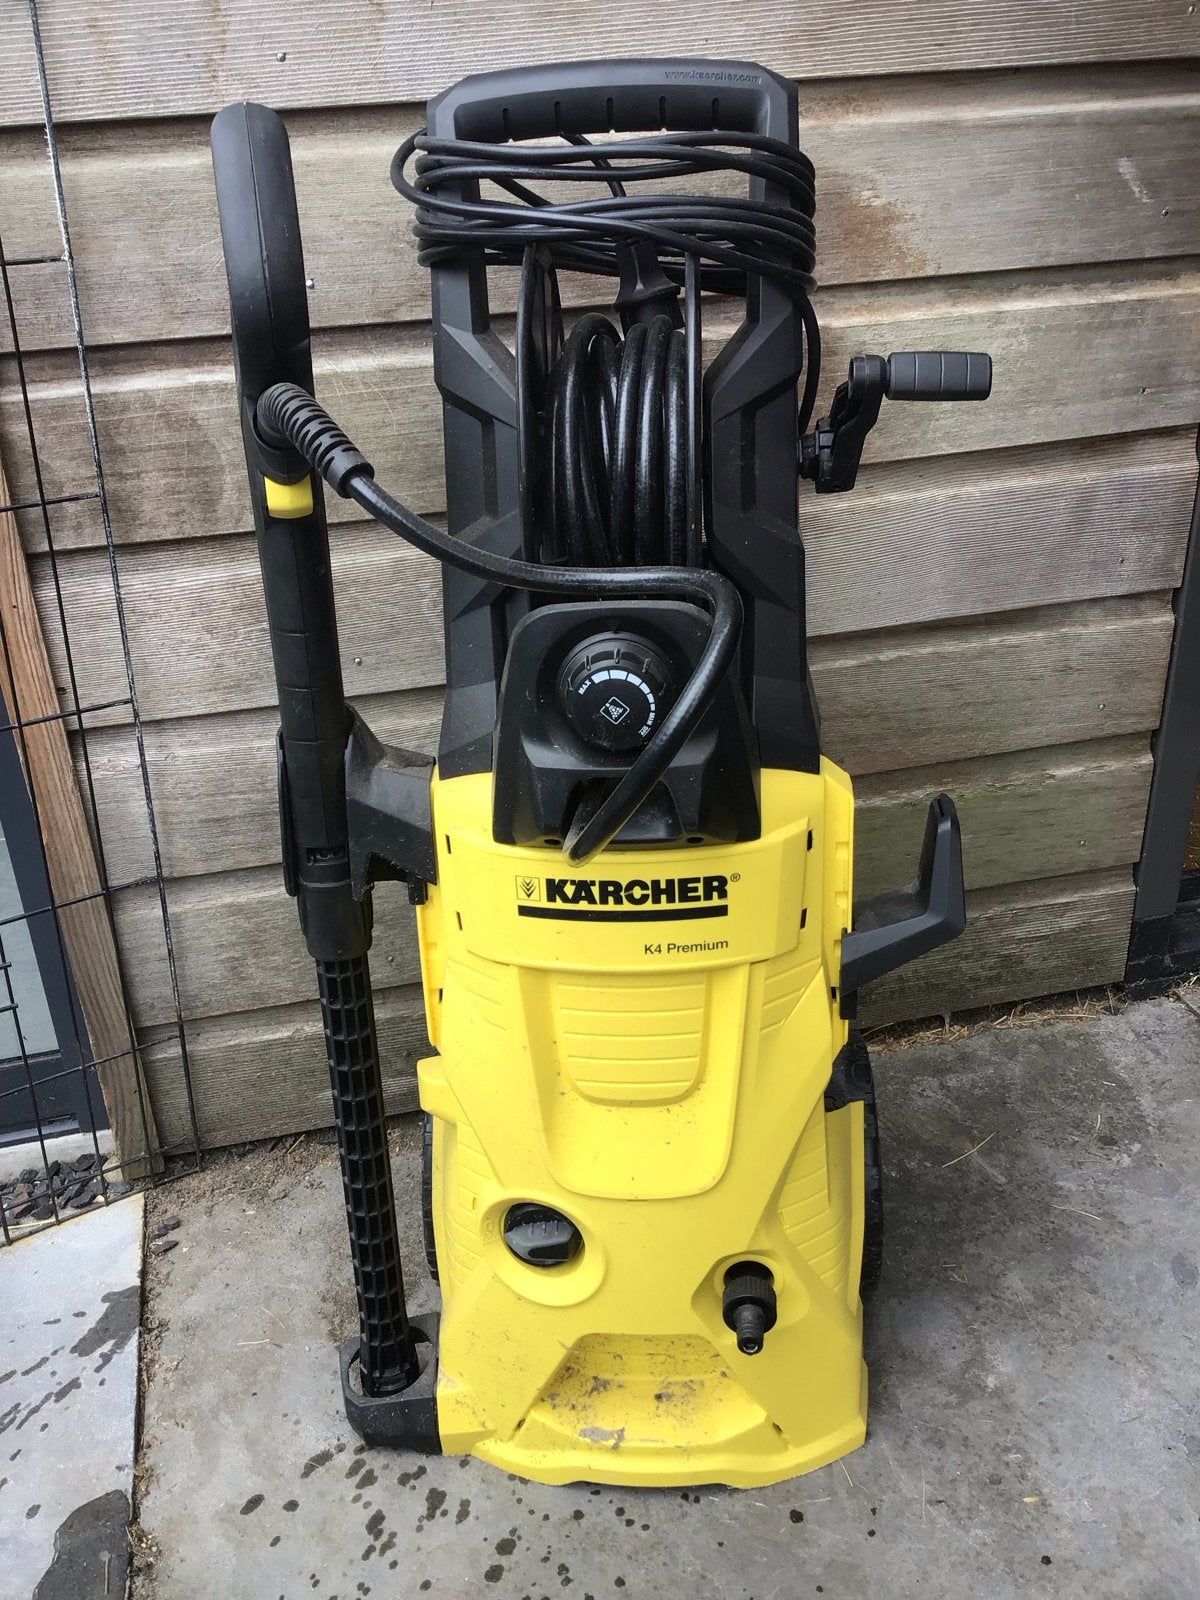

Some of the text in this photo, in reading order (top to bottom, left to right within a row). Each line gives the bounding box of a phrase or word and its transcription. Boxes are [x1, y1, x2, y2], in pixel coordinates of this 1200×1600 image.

[664, 70, 762, 84] www.kaercher.com
[578, 679, 592, 695] MAX
[644, 940, 729, 955] K4 Premium
